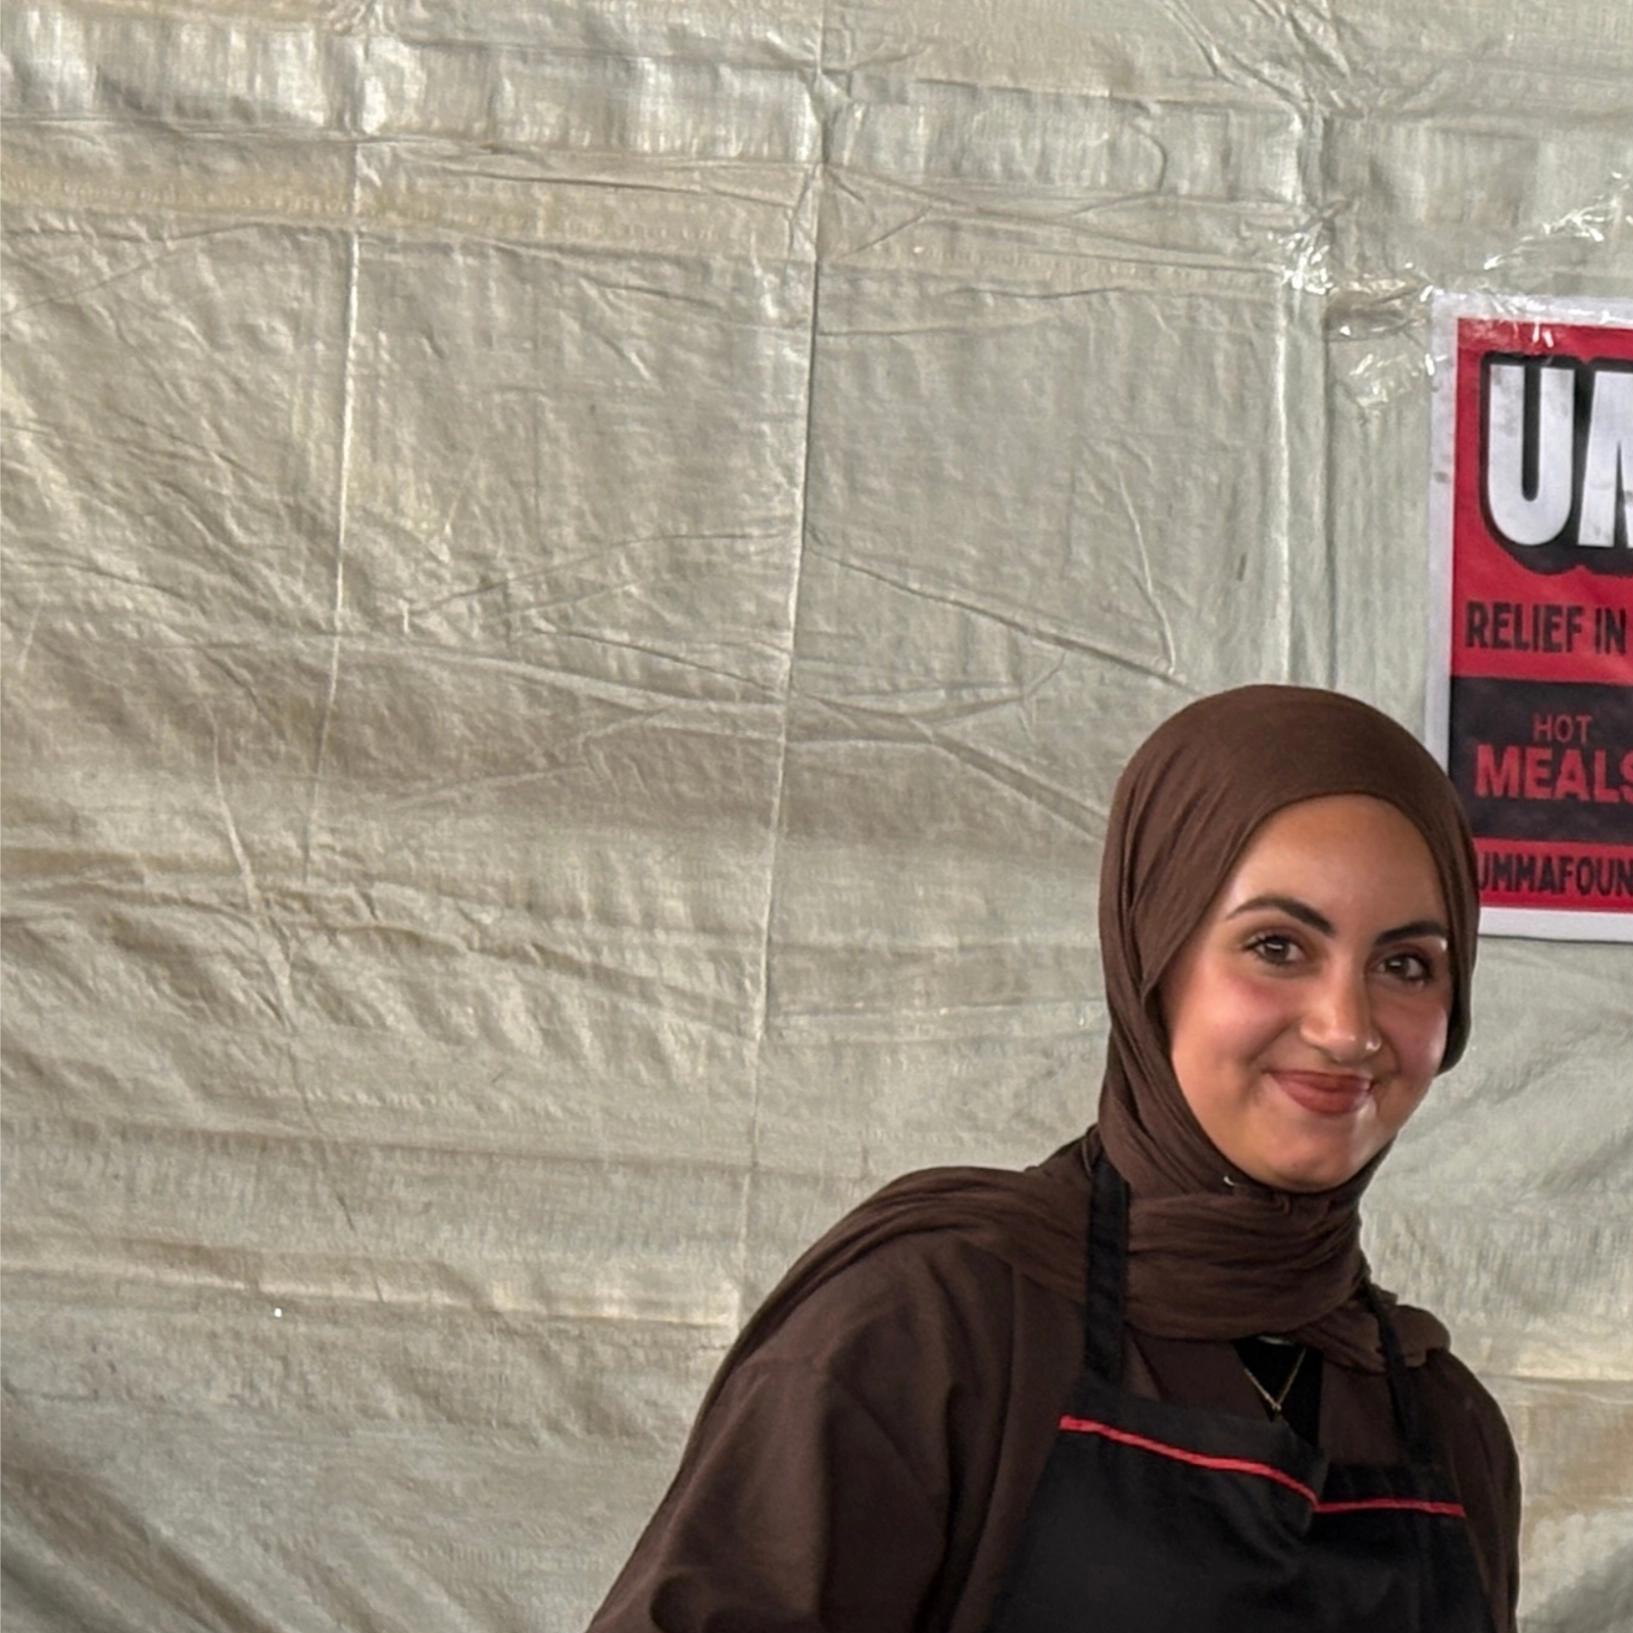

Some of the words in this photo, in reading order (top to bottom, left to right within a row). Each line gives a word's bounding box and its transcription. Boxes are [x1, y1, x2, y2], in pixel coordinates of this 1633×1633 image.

[1465, 602, 1586, 655] RELIEF
[1595, 608, 1628, 656] IN
[1532, 713, 1593, 746] HOT
